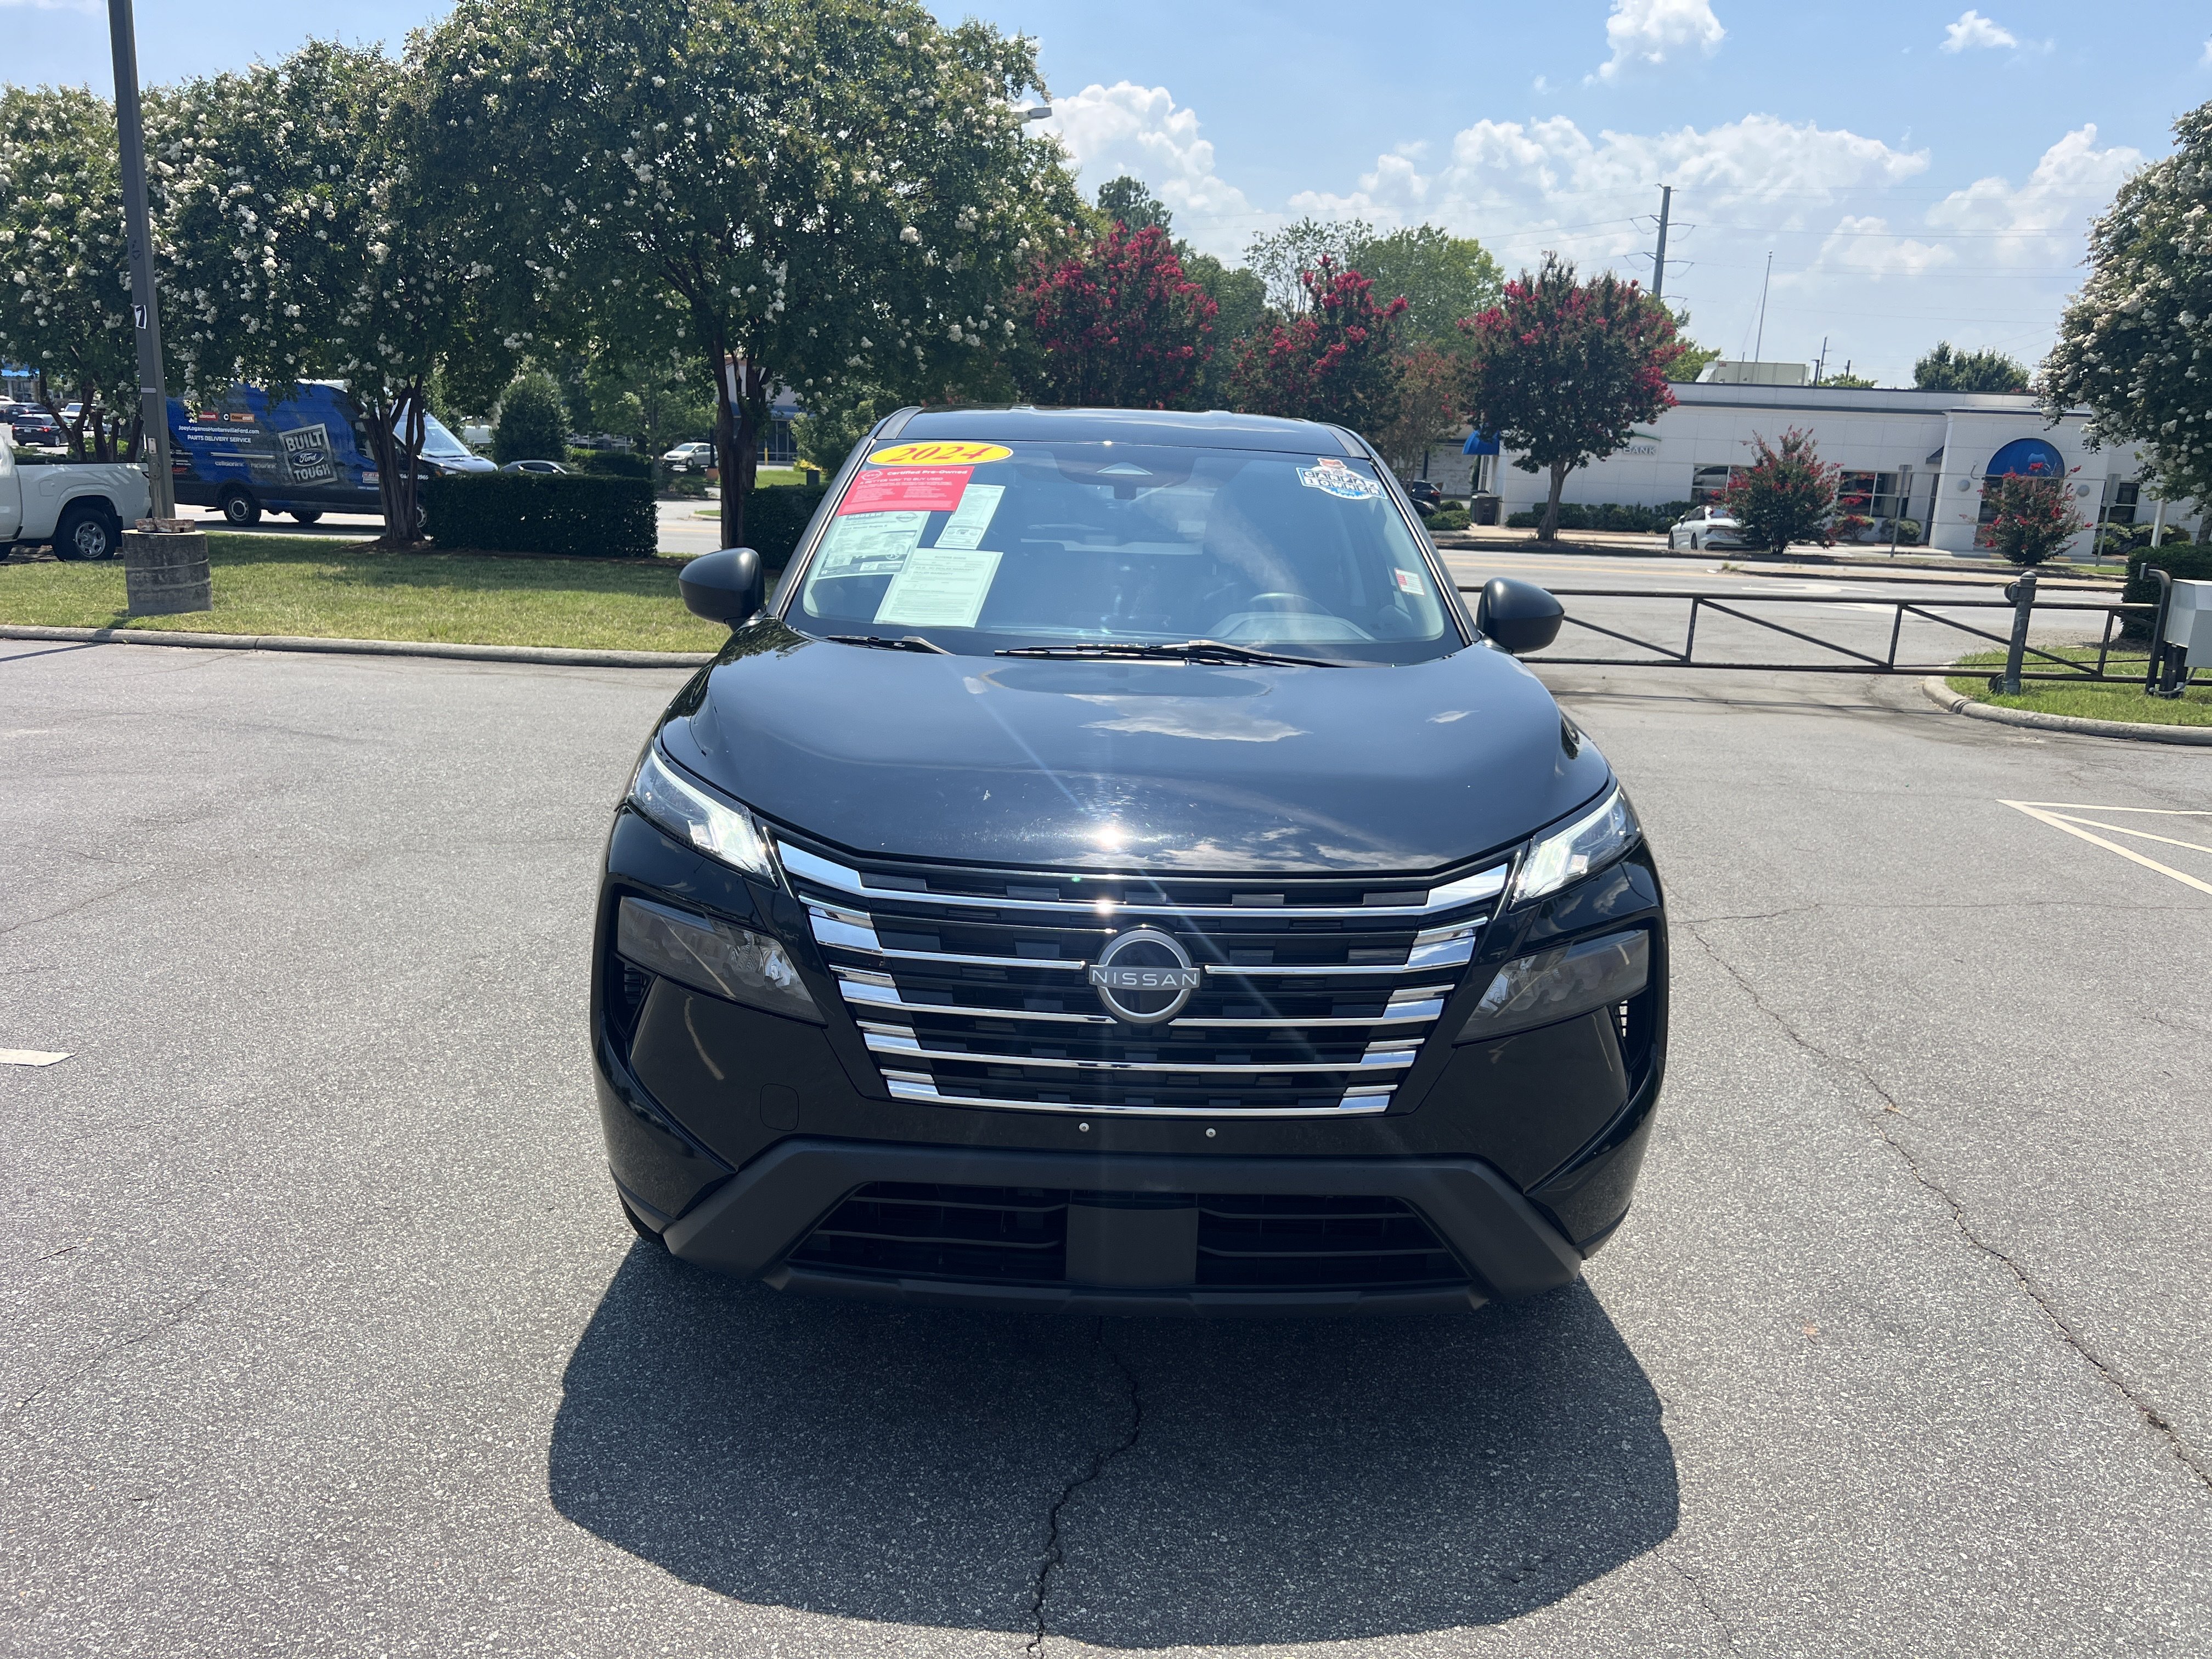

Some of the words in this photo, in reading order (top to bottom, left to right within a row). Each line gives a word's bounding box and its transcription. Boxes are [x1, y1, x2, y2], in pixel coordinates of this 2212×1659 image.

[285, 431, 321, 452] BUILT
[299, 453, 317, 464] Ford
[885, 446, 993, 462] 2024
[1623, 447, 1656, 455] BANK
[294, 464, 331, 481] TOUGH
[1304, 471, 1378, 490] CARFAX
[1319, 480, 1380, 495] OWNER
[1091, 969, 1198, 986] NISSAN
